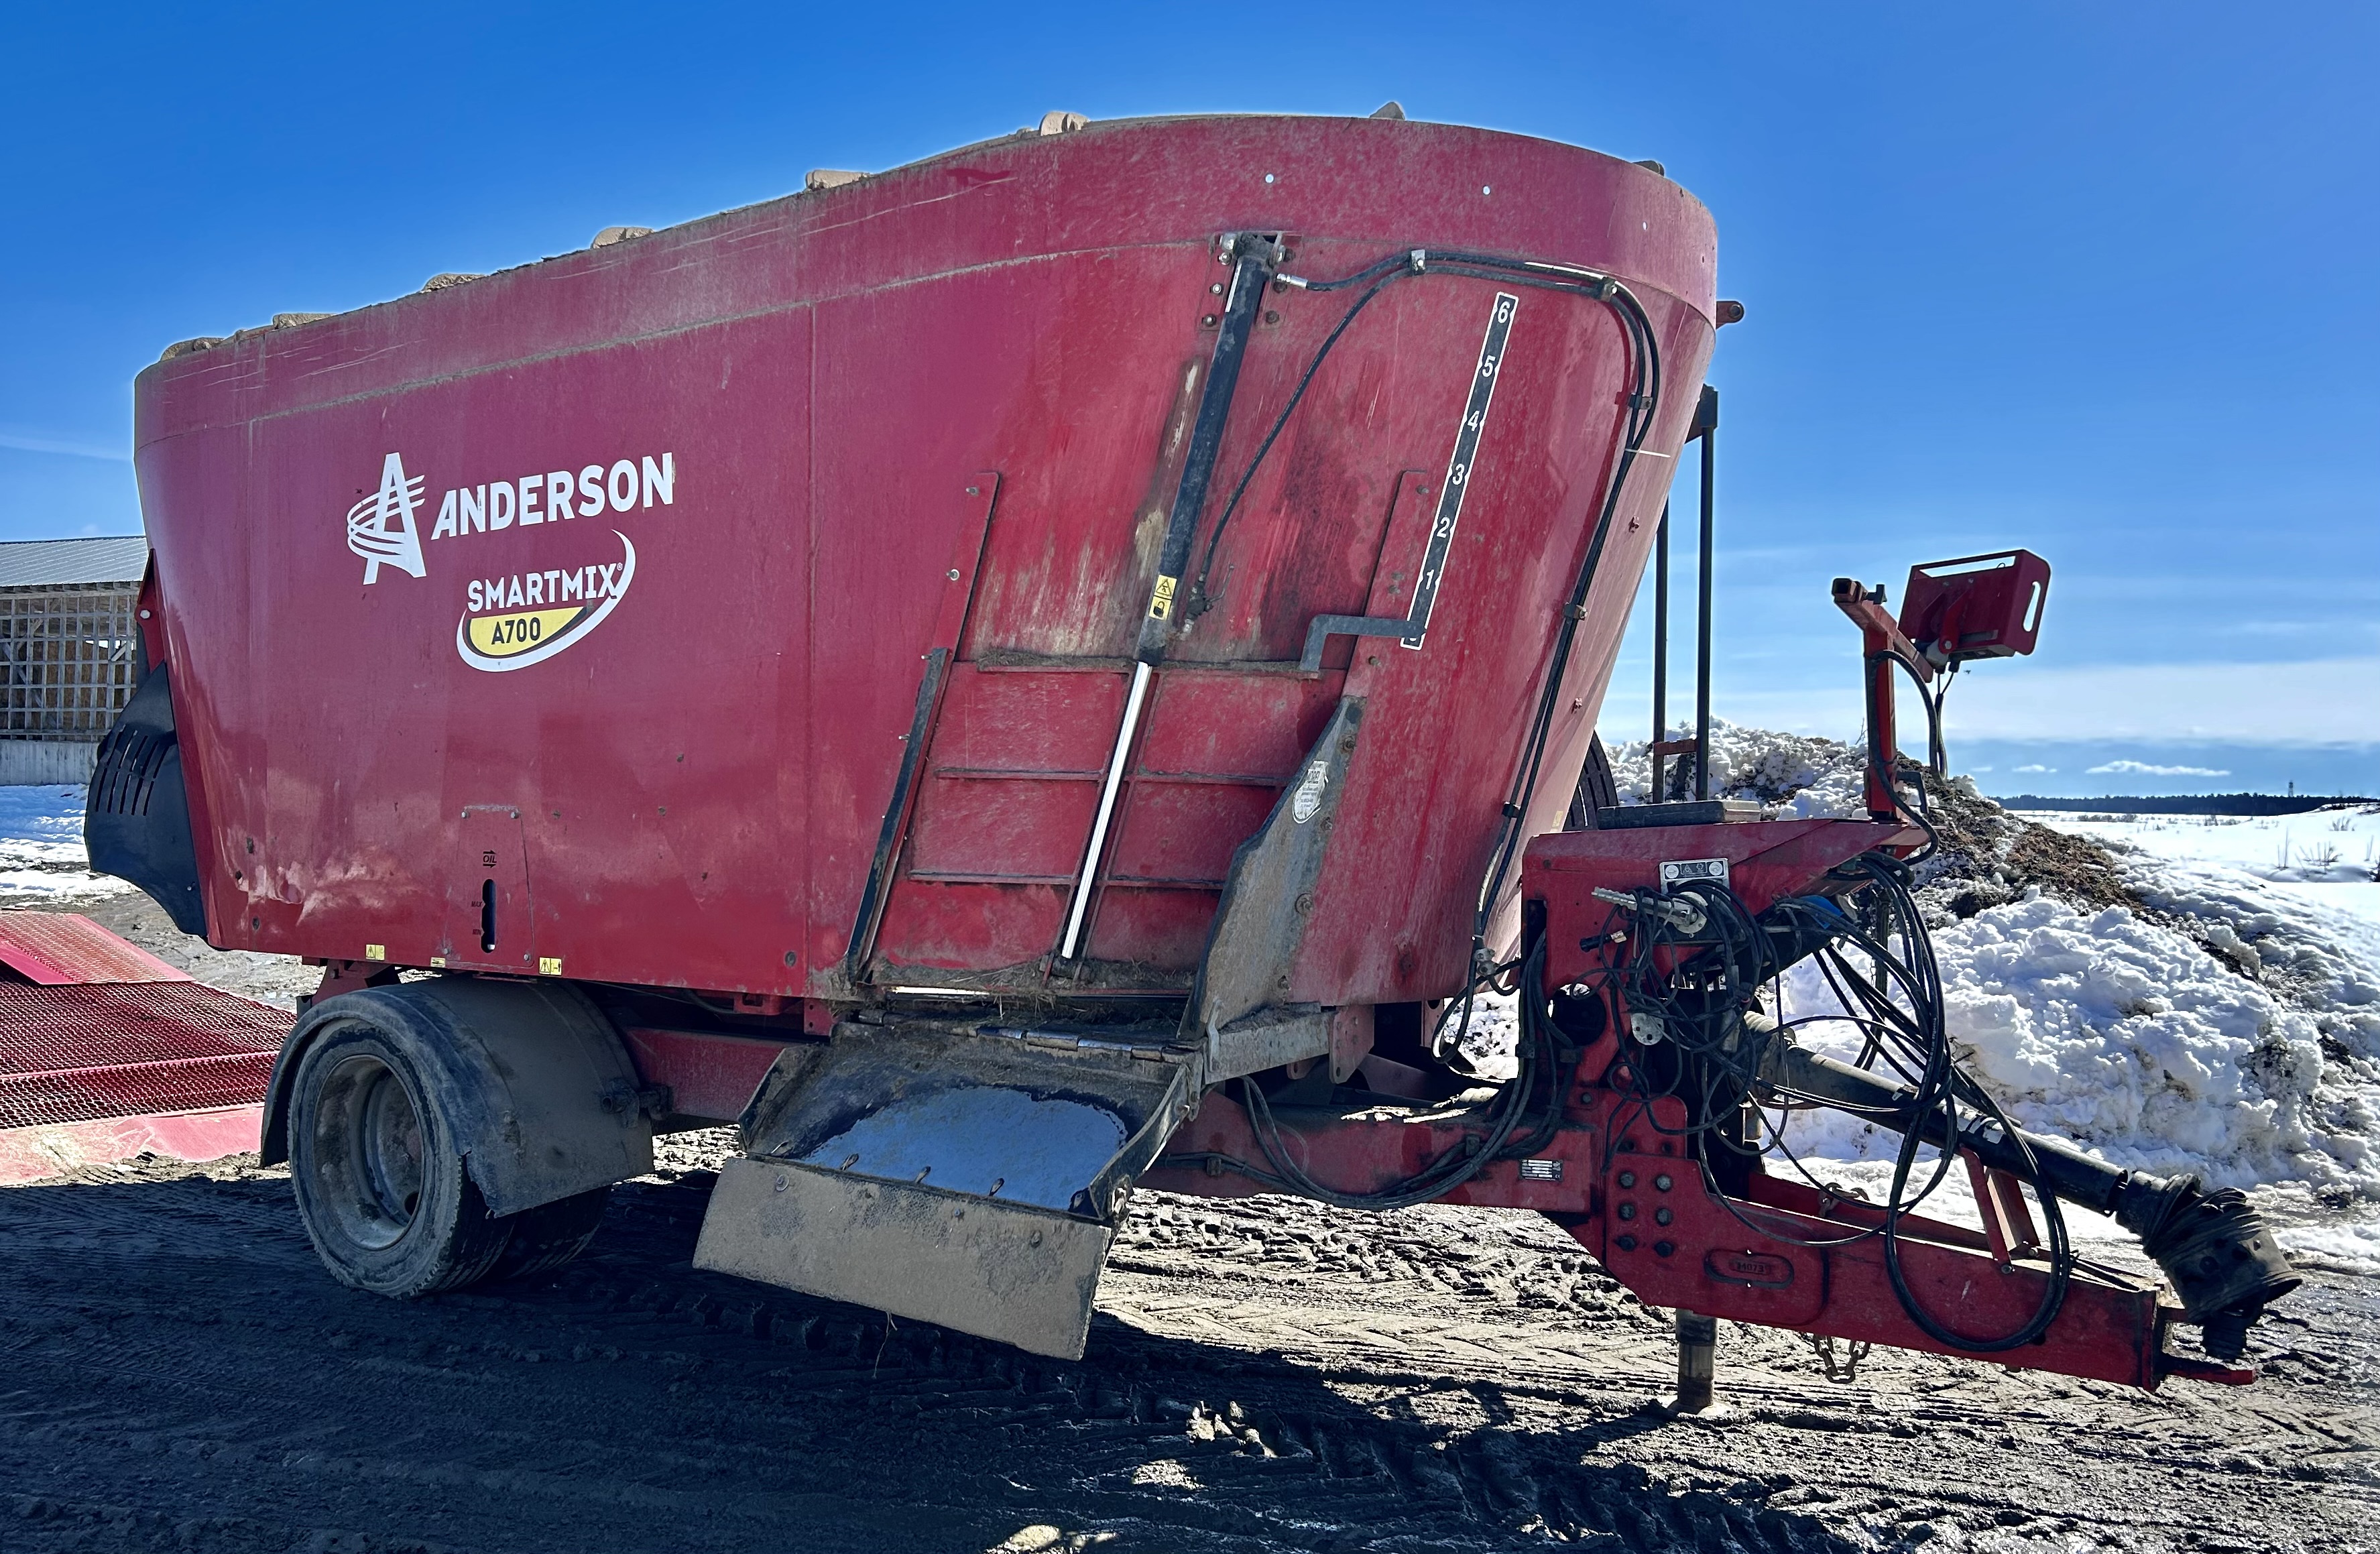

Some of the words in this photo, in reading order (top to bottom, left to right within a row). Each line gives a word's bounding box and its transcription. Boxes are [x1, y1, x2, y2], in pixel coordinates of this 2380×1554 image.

[1497, 301, 1511, 324] 6
[1482, 355, 1496, 377] 5
[1467, 410, 1480, 432] 4
[1451, 463, 1466, 485] 3
[430, 452, 674, 540] ANDERSON
[1437, 517, 1451, 538] 2
[1423, 569, 1435, 590] 1
[491, 617, 541, 646] A700
[483, 855, 497, 863] OIL
